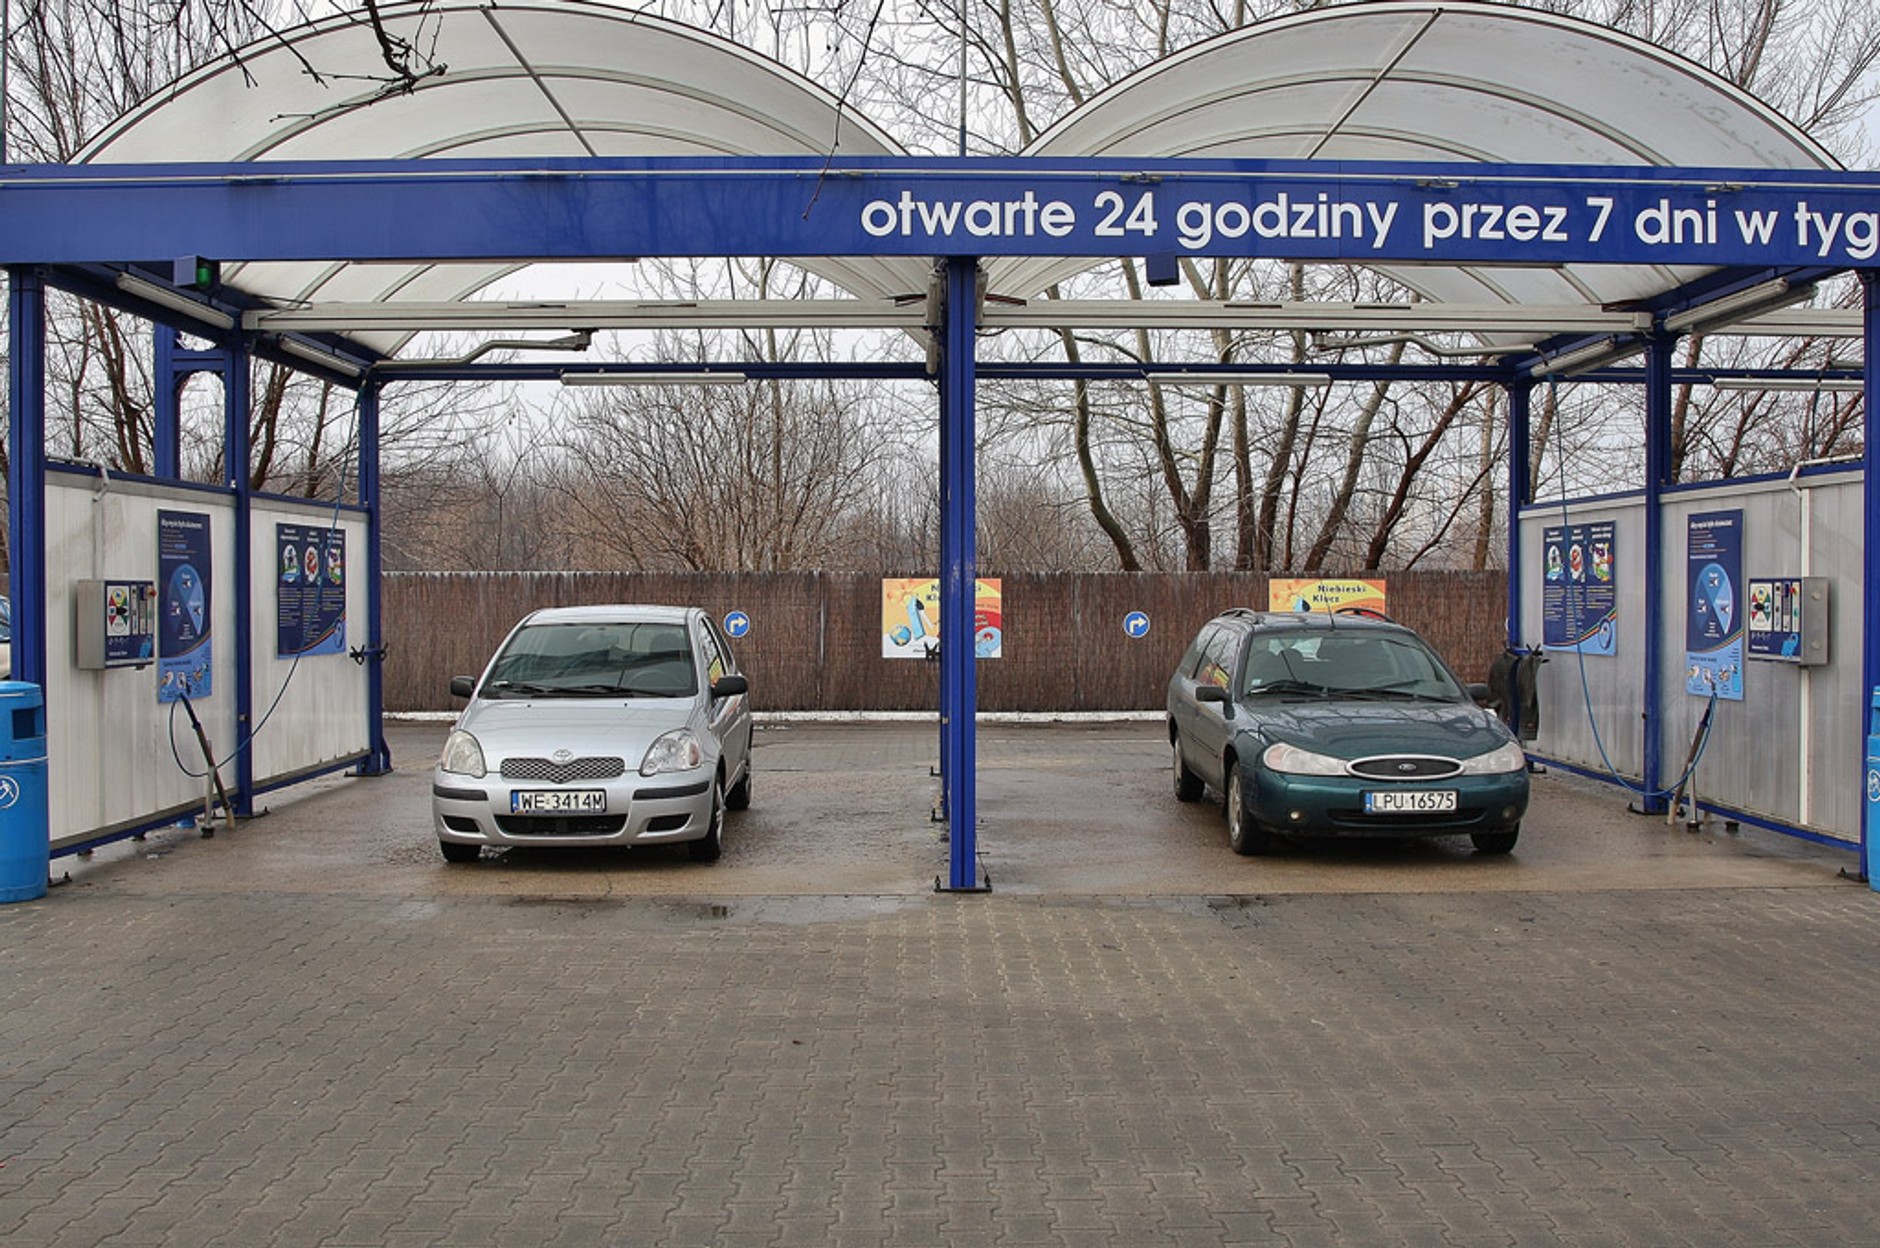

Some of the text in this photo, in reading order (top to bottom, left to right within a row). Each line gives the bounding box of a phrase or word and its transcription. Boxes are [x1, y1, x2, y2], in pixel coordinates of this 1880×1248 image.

[861, 190, 1880, 260] otwarte 24 godziny przez 7 dni w tyg
